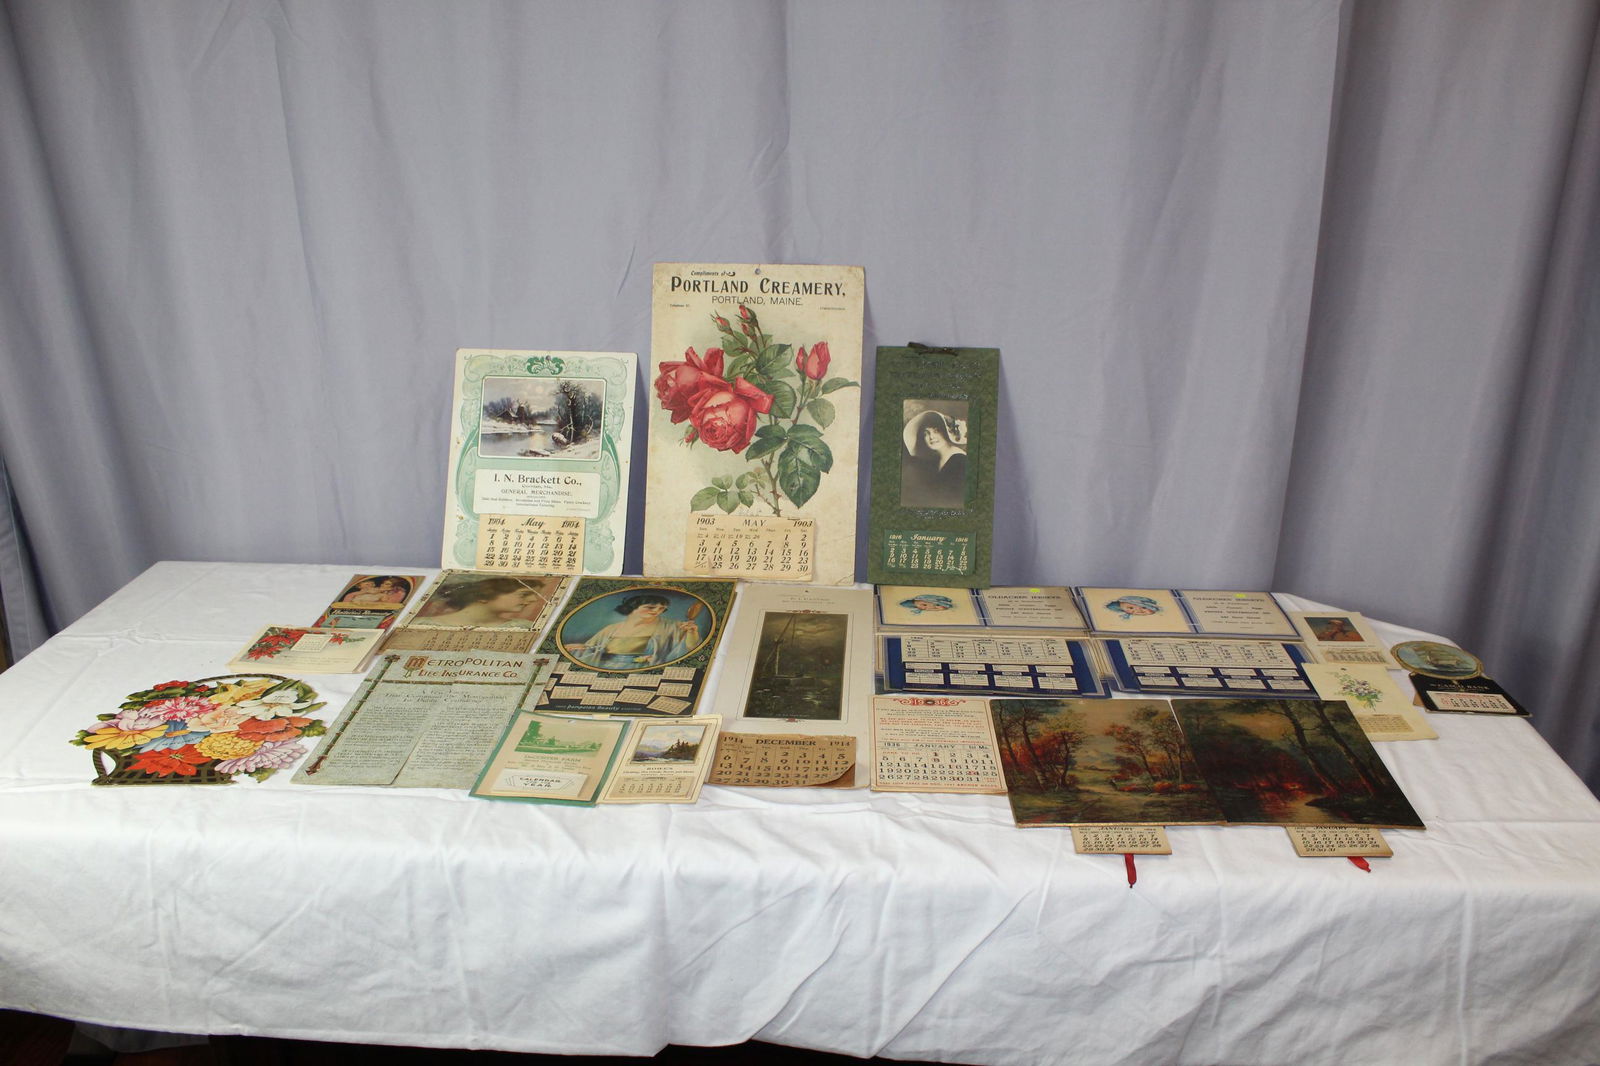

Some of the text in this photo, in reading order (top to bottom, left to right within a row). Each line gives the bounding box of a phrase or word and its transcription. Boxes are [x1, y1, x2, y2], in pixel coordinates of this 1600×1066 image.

[671, 276, 846, 297] PORTLAND CREAMERY,
[712, 296, 766, 305] PORTLAND,
[504, 474, 514, 483] N.
[518, 474, 560, 485] Brackett
[521, 517, 544, 529] May
[743, 519, 767, 527] MAY
[910, 533, 945, 542] January
[764, 548, 774, 556] 14
[799, 549, 809, 557] 16
[713, 554, 723, 562] 18
[746, 555, 757, 563] 20
[780, 556, 792, 564] 22
[711, 561, 723, 569] 25
[729, 562, 739, 570] 26
[762, 563, 774, 571] 28
[404, 656, 524, 668] METROPOLITAN
[441, 669, 501, 678] INSURANCE
